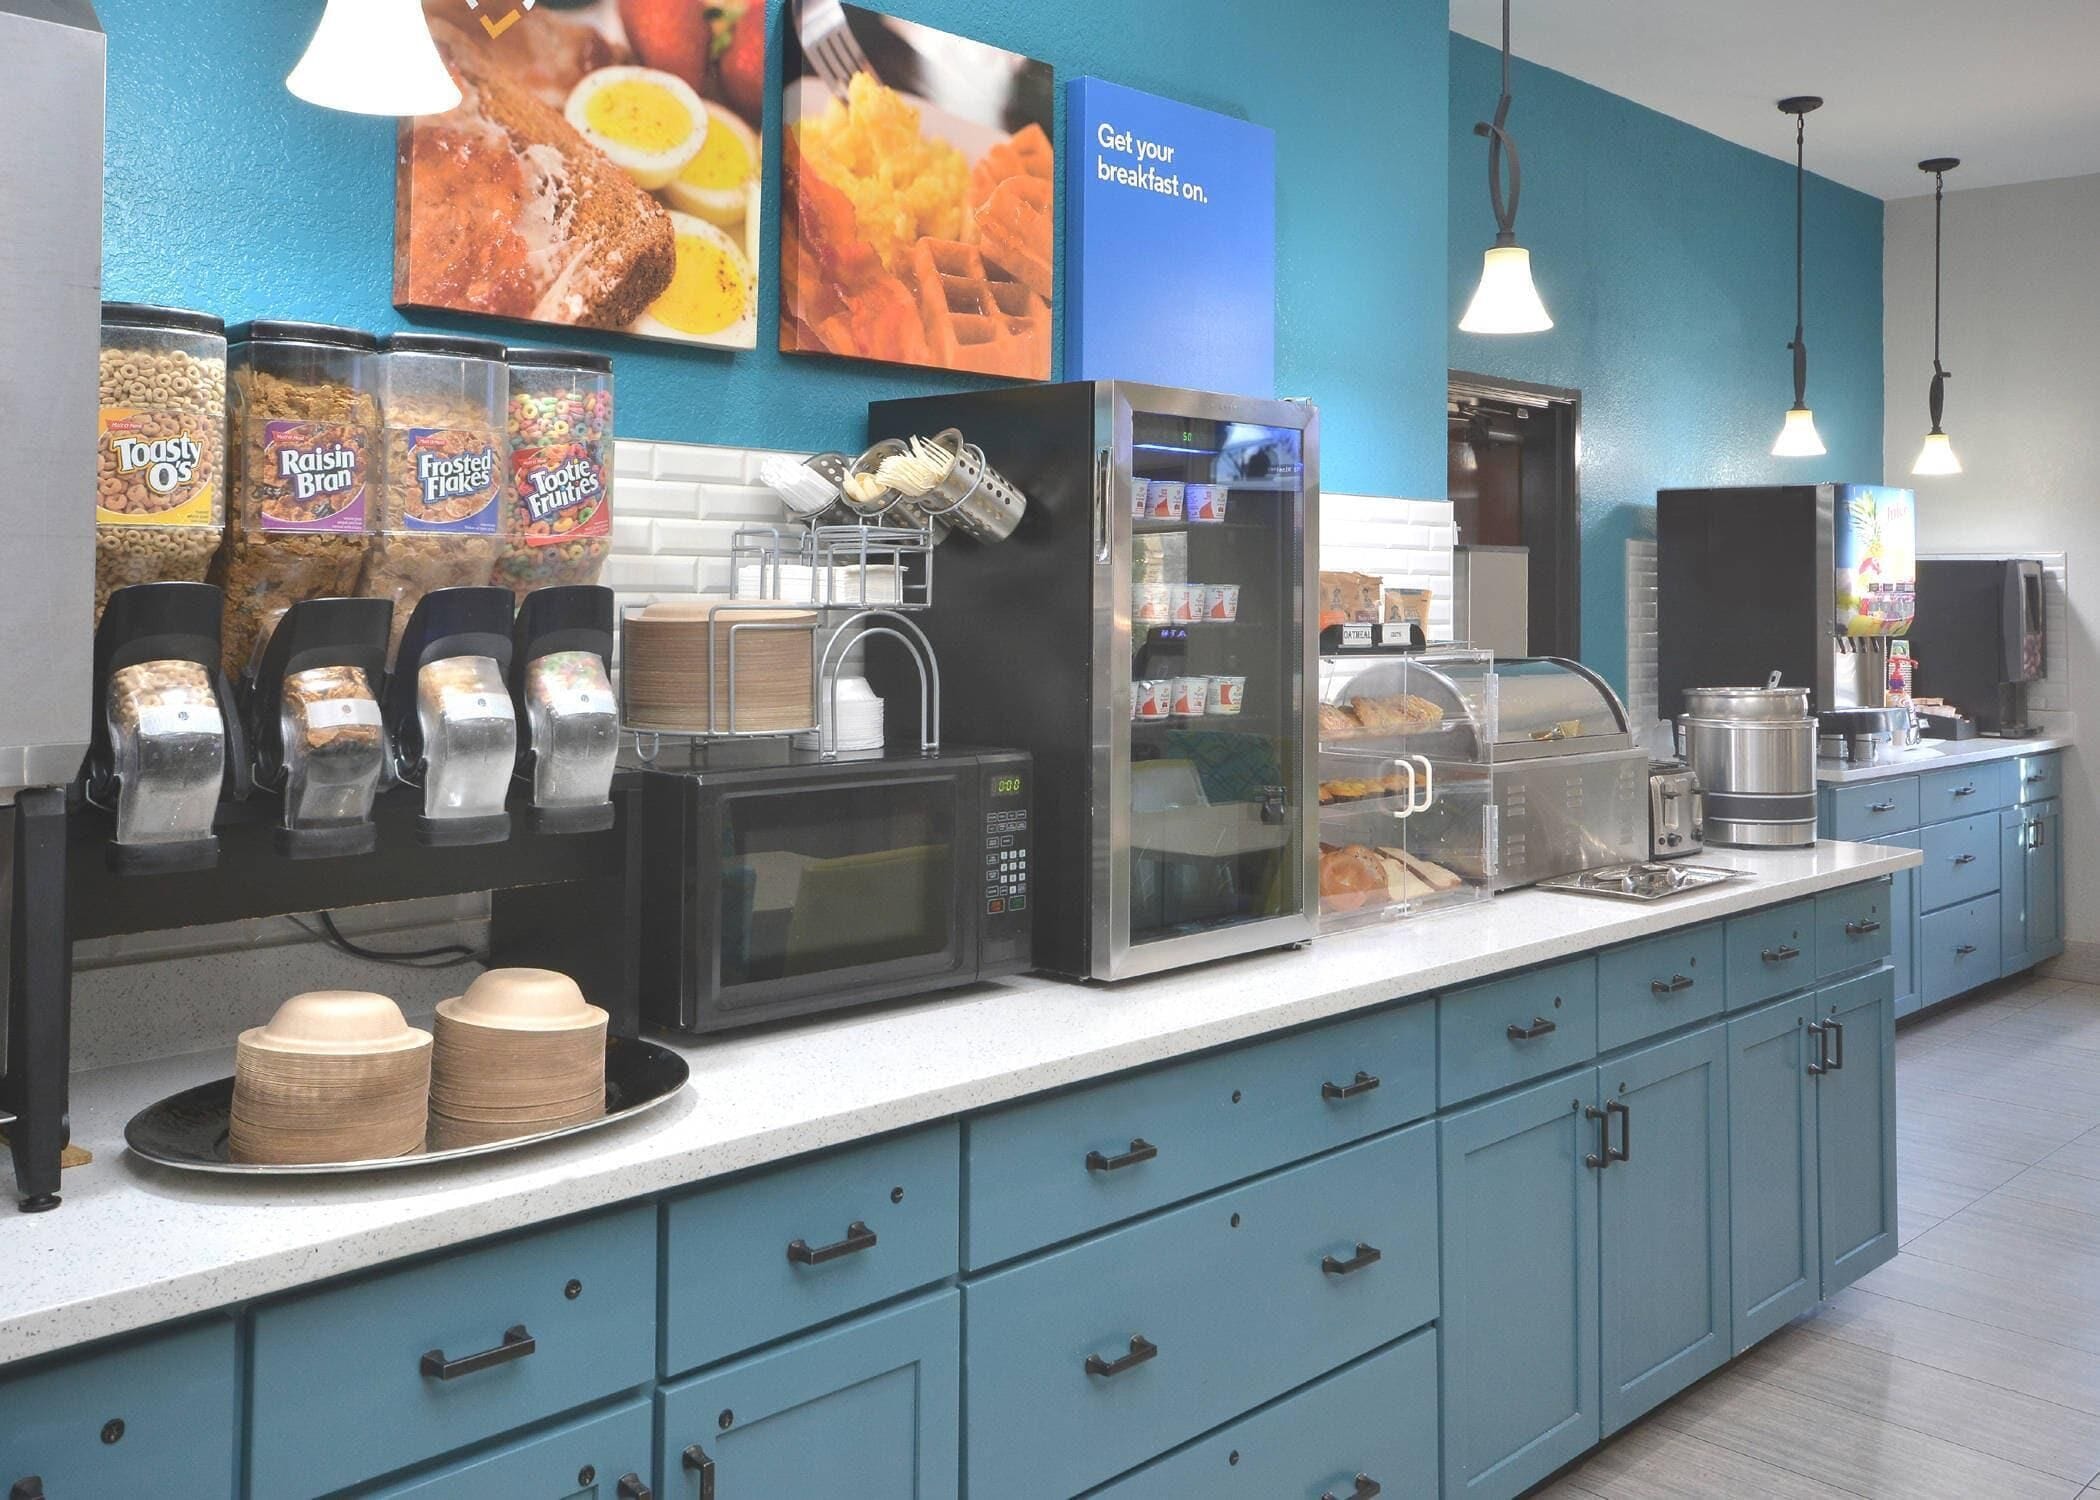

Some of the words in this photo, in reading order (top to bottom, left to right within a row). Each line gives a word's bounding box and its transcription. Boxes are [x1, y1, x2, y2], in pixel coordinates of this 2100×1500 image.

[1097, 122, 1133, 154] Get
[1136, 139, 1175, 163] your
[1097, 154, 1179, 197] breakfast
[1182, 181, 1208, 204] on.
[112, 430, 202, 473] Toasty
[280, 443, 356, 476] Raisin
[420, 448, 492, 479] Frosted
[147, 459, 193, 493] O's
[295, 468, 353, 499] Bran
[426, 470, 490, 501] Flakes
[529, 458, 592, 496] Tootie
[527, 472, 600, 518] Fruities
[1343, 630, 1372, 640] OATMEAL
